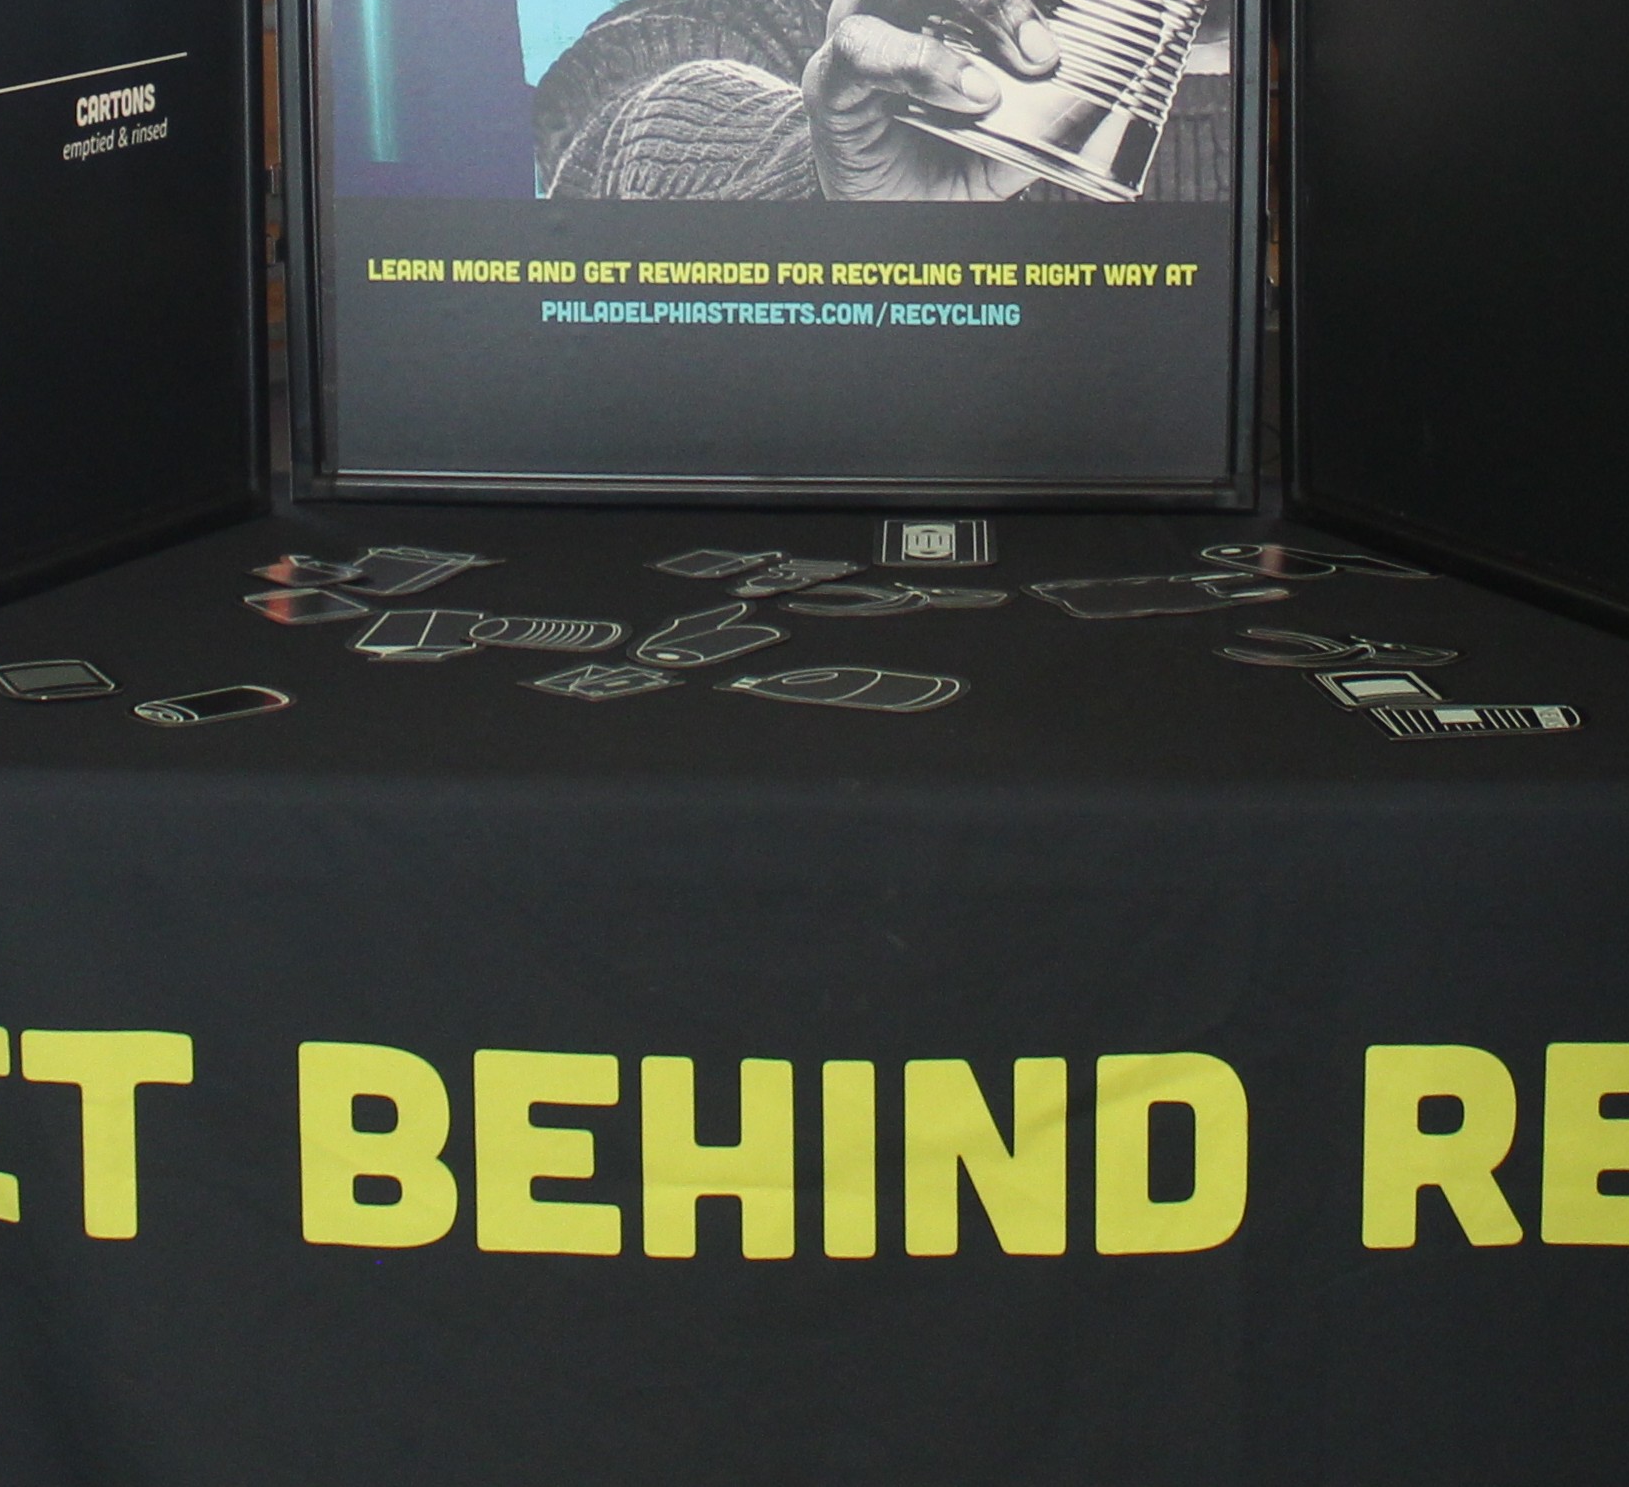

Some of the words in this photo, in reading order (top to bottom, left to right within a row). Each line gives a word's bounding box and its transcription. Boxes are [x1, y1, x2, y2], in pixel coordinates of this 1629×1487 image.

[76, 83, 156, 127] CARTONS
[62, 128, 115, 161] emptied
[117, 126, 129, 148] &
[131, 117, 168, 145] rinsed
[368, 258, 445, 282] LEARN
[452, 259, 521, 283] MORE
[527, 260, 577, 283] AND
[583, 260, 632, 284] GET
[638, 261, 770, 285] REWARDED
[777, 262, 825, 285] FOR
[831, 262, 962, 286] RECYCLING
[968, 263, 1018, 286] THE
[1025, 263, 1098, 286] RIGHT
[1103, 263, 1159, 286] WAY
[1165, 263, 1198, 286] AT
[541, 300, 1021, 328] PHILADELPHIASTREETS.COM/RECYCLING
[298, 1042, 1249, 1260] BEHIND
